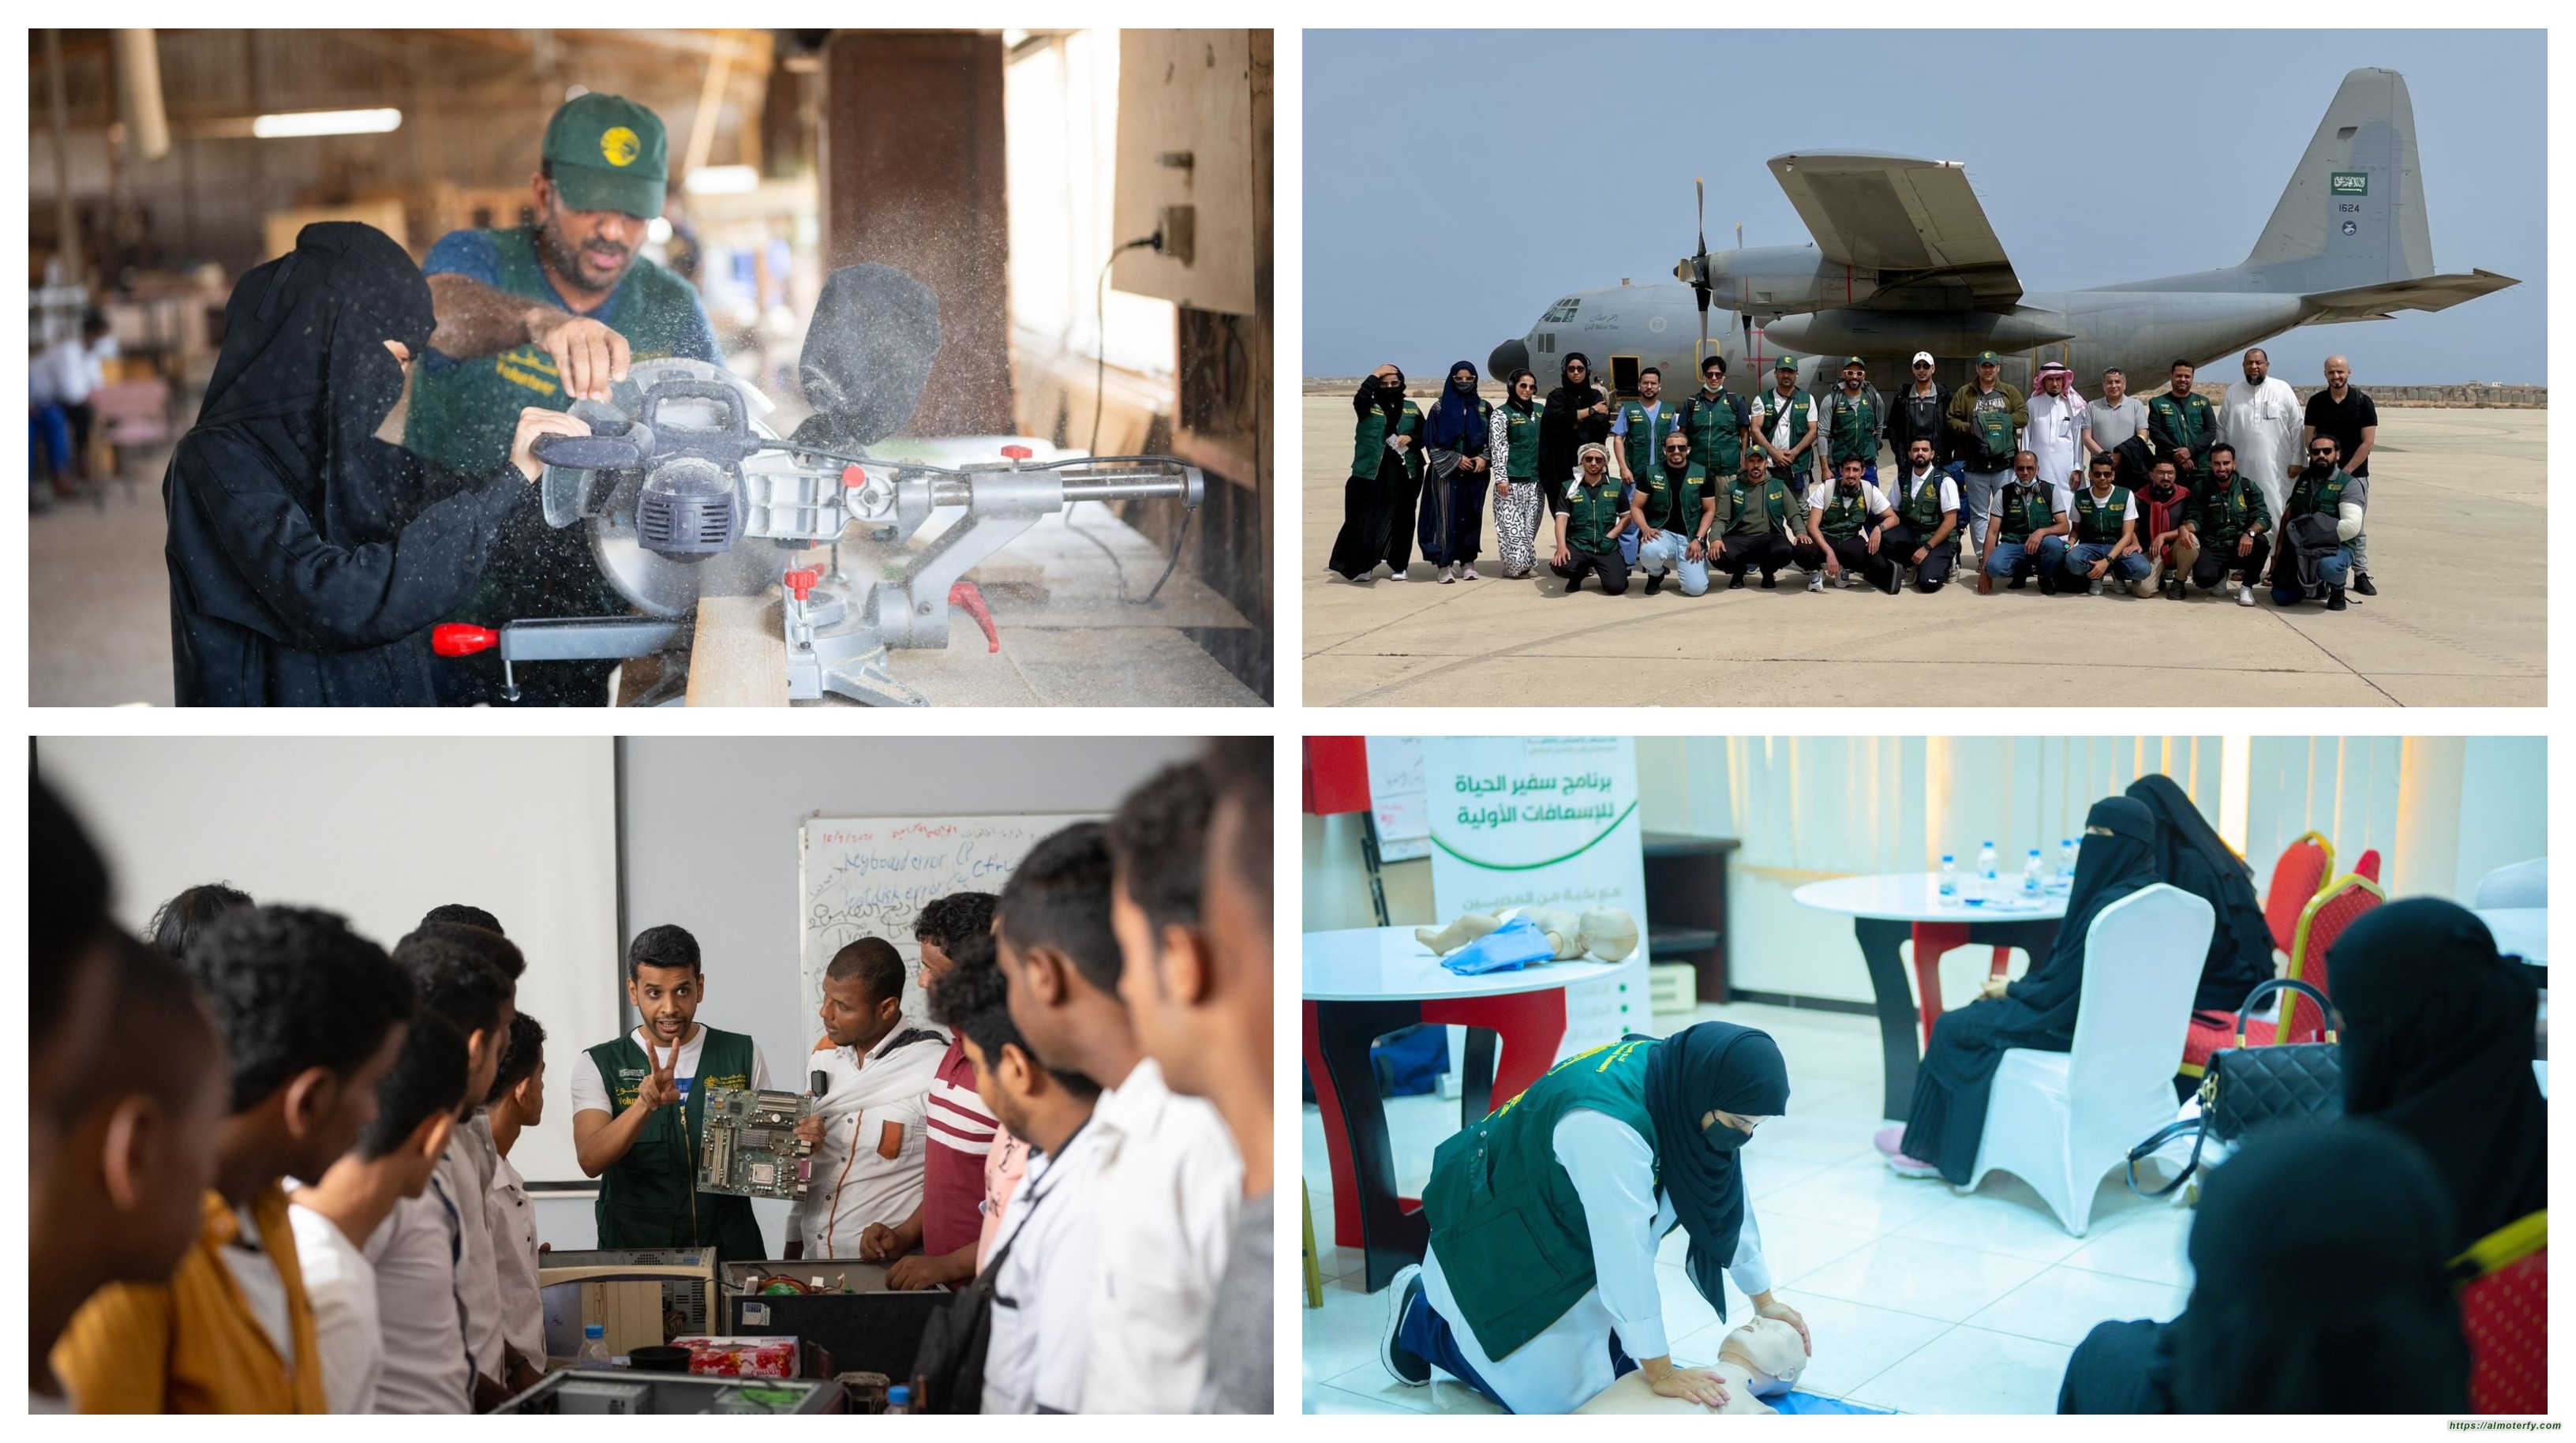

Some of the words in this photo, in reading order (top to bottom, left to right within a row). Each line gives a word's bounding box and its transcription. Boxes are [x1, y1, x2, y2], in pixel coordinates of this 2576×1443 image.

[2338, 204, 2360, 212] 1624
[1455, 774, 1507, 798] الحياة
[1511, 773, 1556, 796] سفير
[1562, 771, 1612, 796] برنامج
[1457, 802, 1517, 829] الأولية
[1522, 801, 1615, 824] للإسعافات
